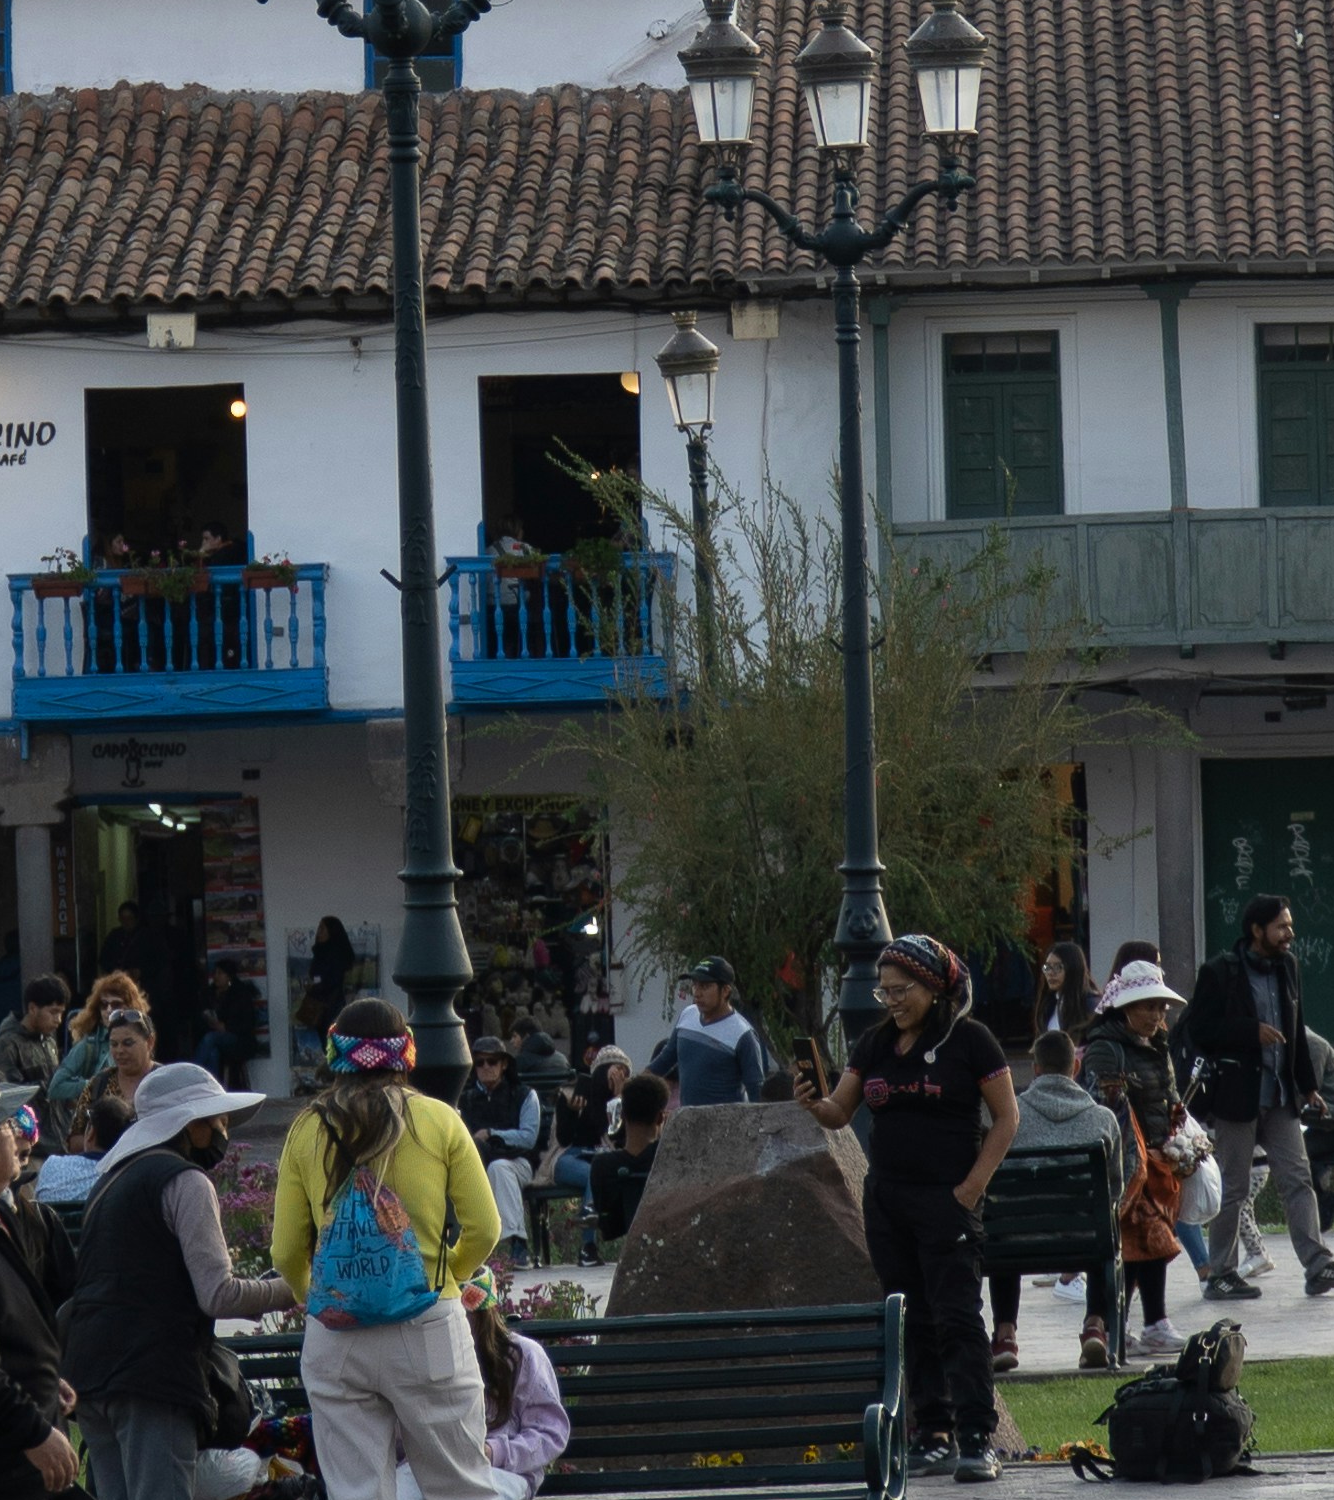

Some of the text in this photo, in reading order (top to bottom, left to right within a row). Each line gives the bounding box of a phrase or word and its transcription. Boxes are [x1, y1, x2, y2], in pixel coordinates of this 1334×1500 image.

[451, 797, 495, 812] ONEY
[55, 845, 68, 935] MASSAGE
[337, 1256, 389, 1280] WORLD
